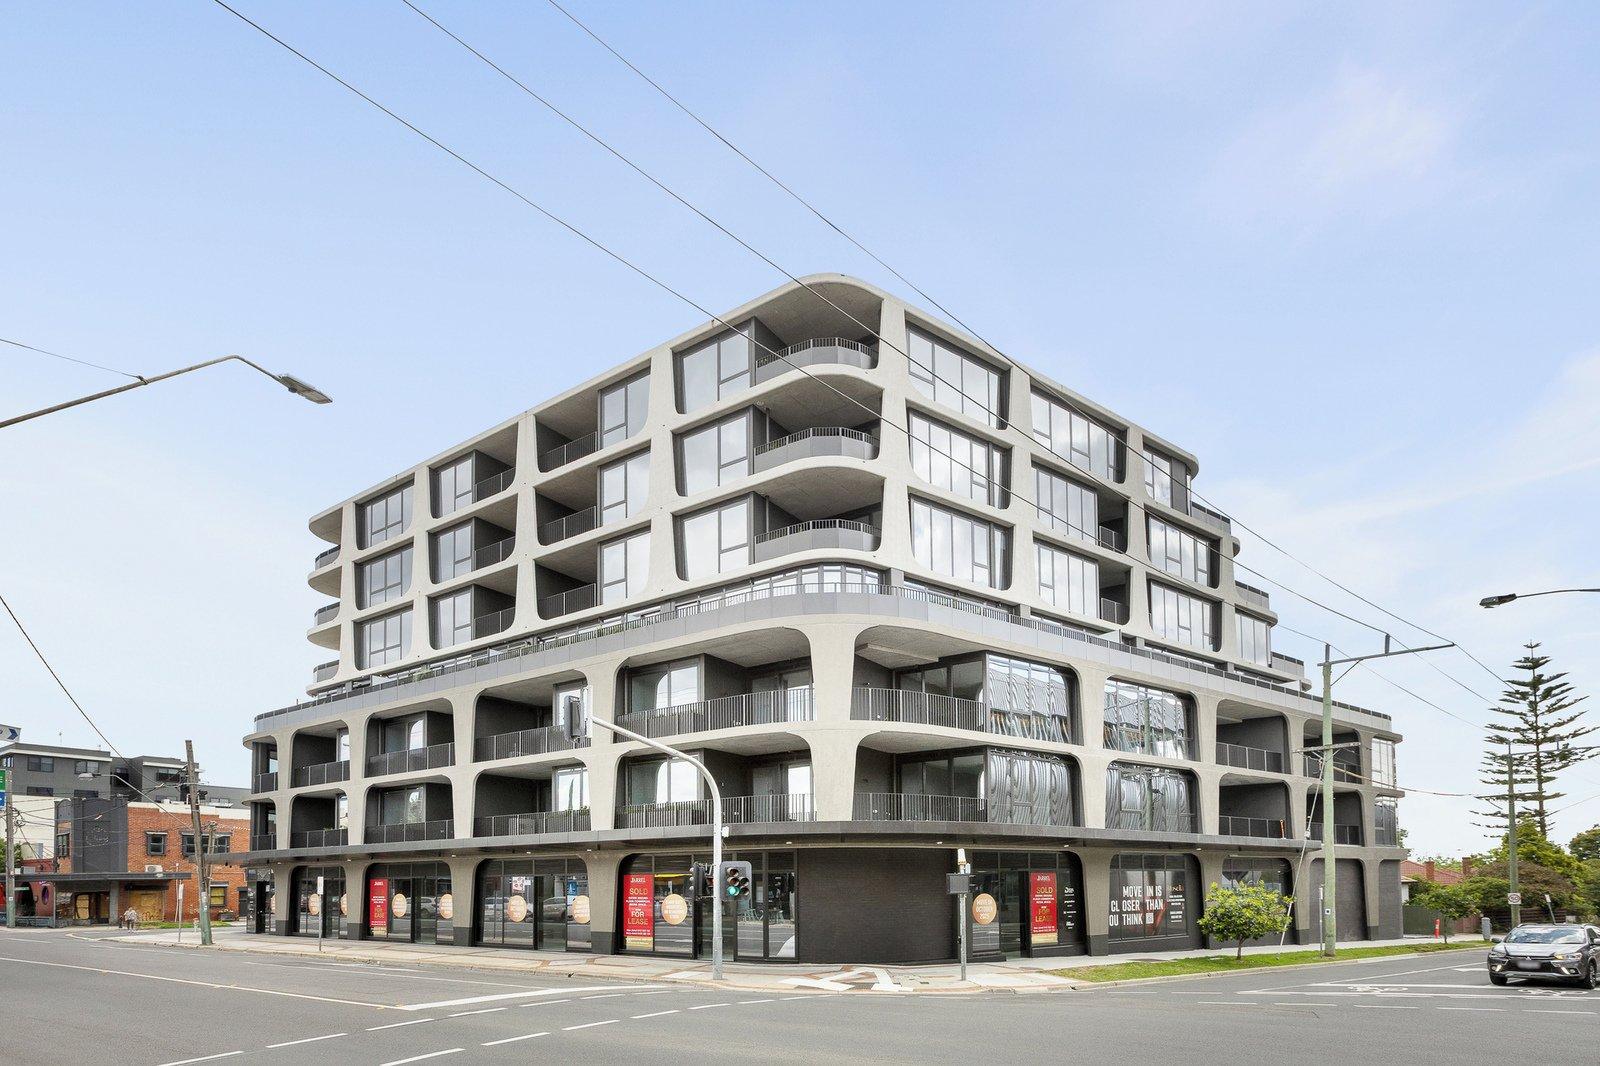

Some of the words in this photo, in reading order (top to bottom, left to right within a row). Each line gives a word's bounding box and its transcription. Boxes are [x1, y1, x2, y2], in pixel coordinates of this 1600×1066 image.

[1123, 886, 1142, 897] MOVE
[1146, 886, 1154, 896] IN
[1155, 885, 1162, 896] IS
[1146, 899, 1163, 910] THAN
[1109, 915, 1119, 926] OU
[1122, 914, 1144, 925] THINK
